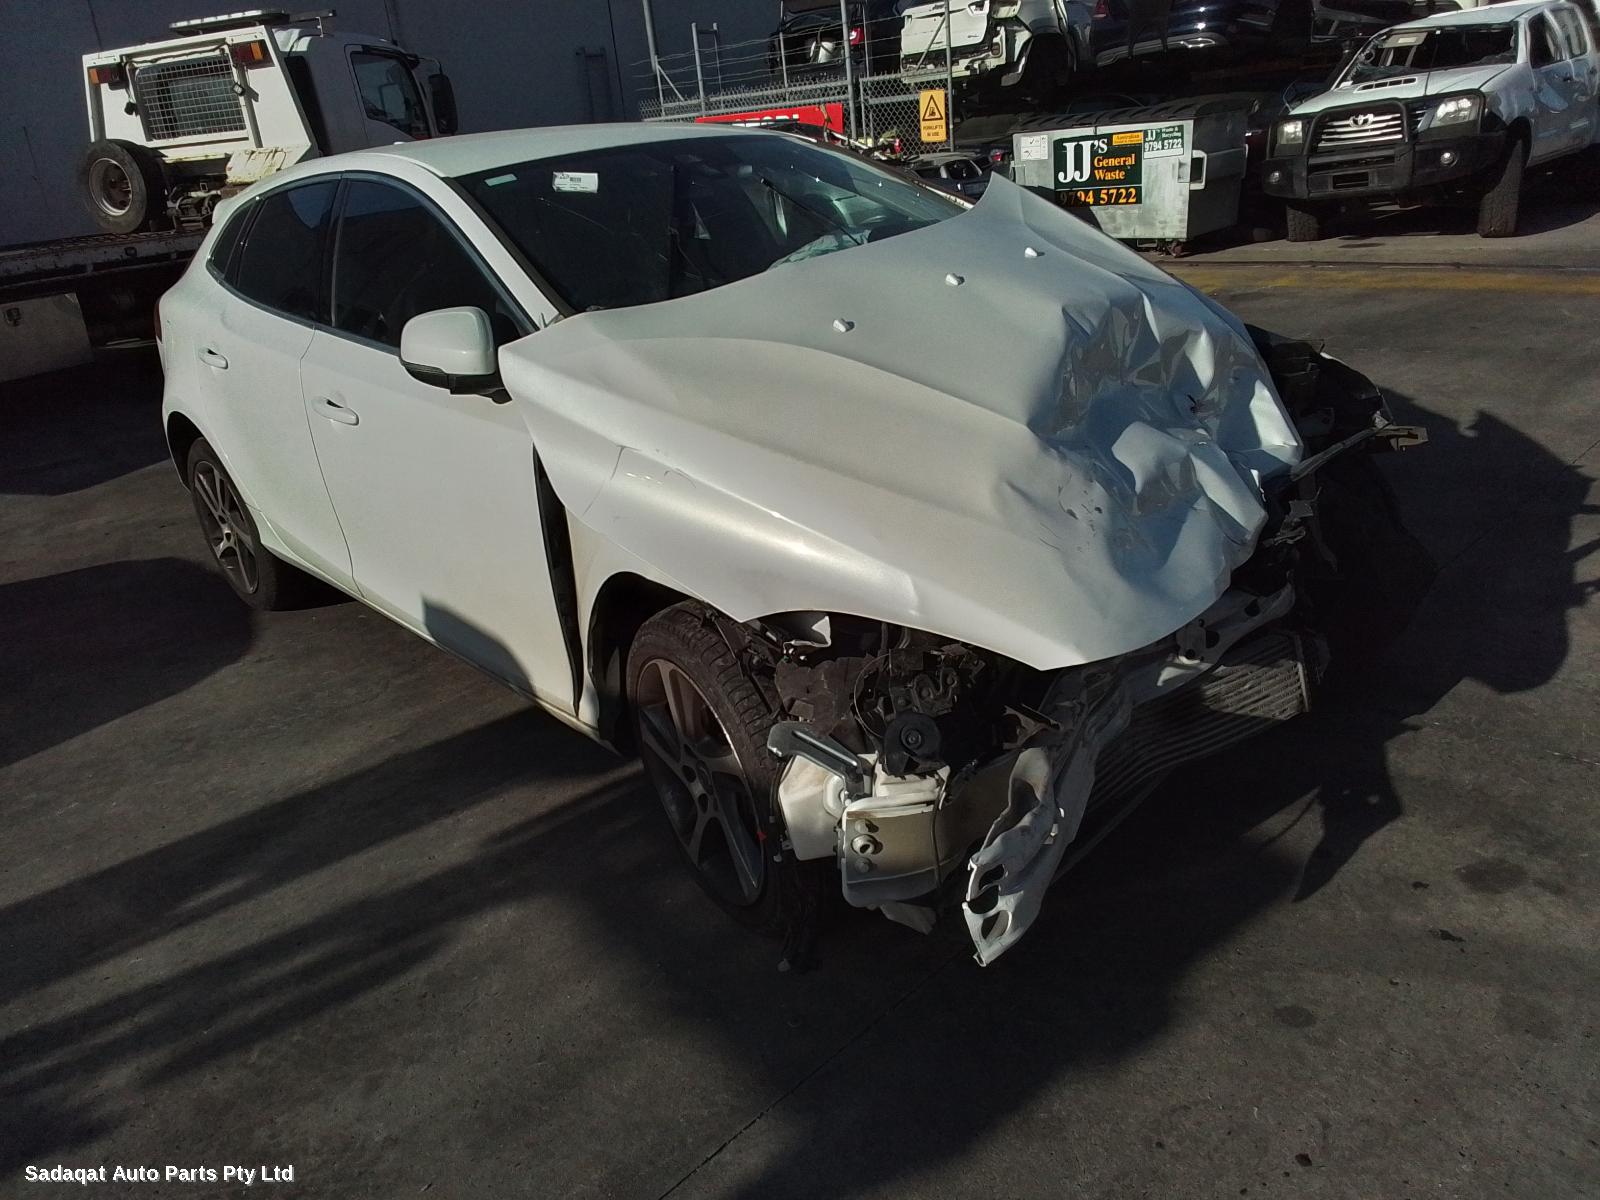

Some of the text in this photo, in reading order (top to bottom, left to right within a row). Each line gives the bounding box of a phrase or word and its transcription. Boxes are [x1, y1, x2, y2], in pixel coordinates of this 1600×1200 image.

[1144, 141, 1162, 152] 9794
[1163, 138, 1182, 150] 5722
[1094, 153, 1136, 168] General
[1094, 168, 1126, 181] Waste
[1060, 187, 1137, 206] 9794 5722
